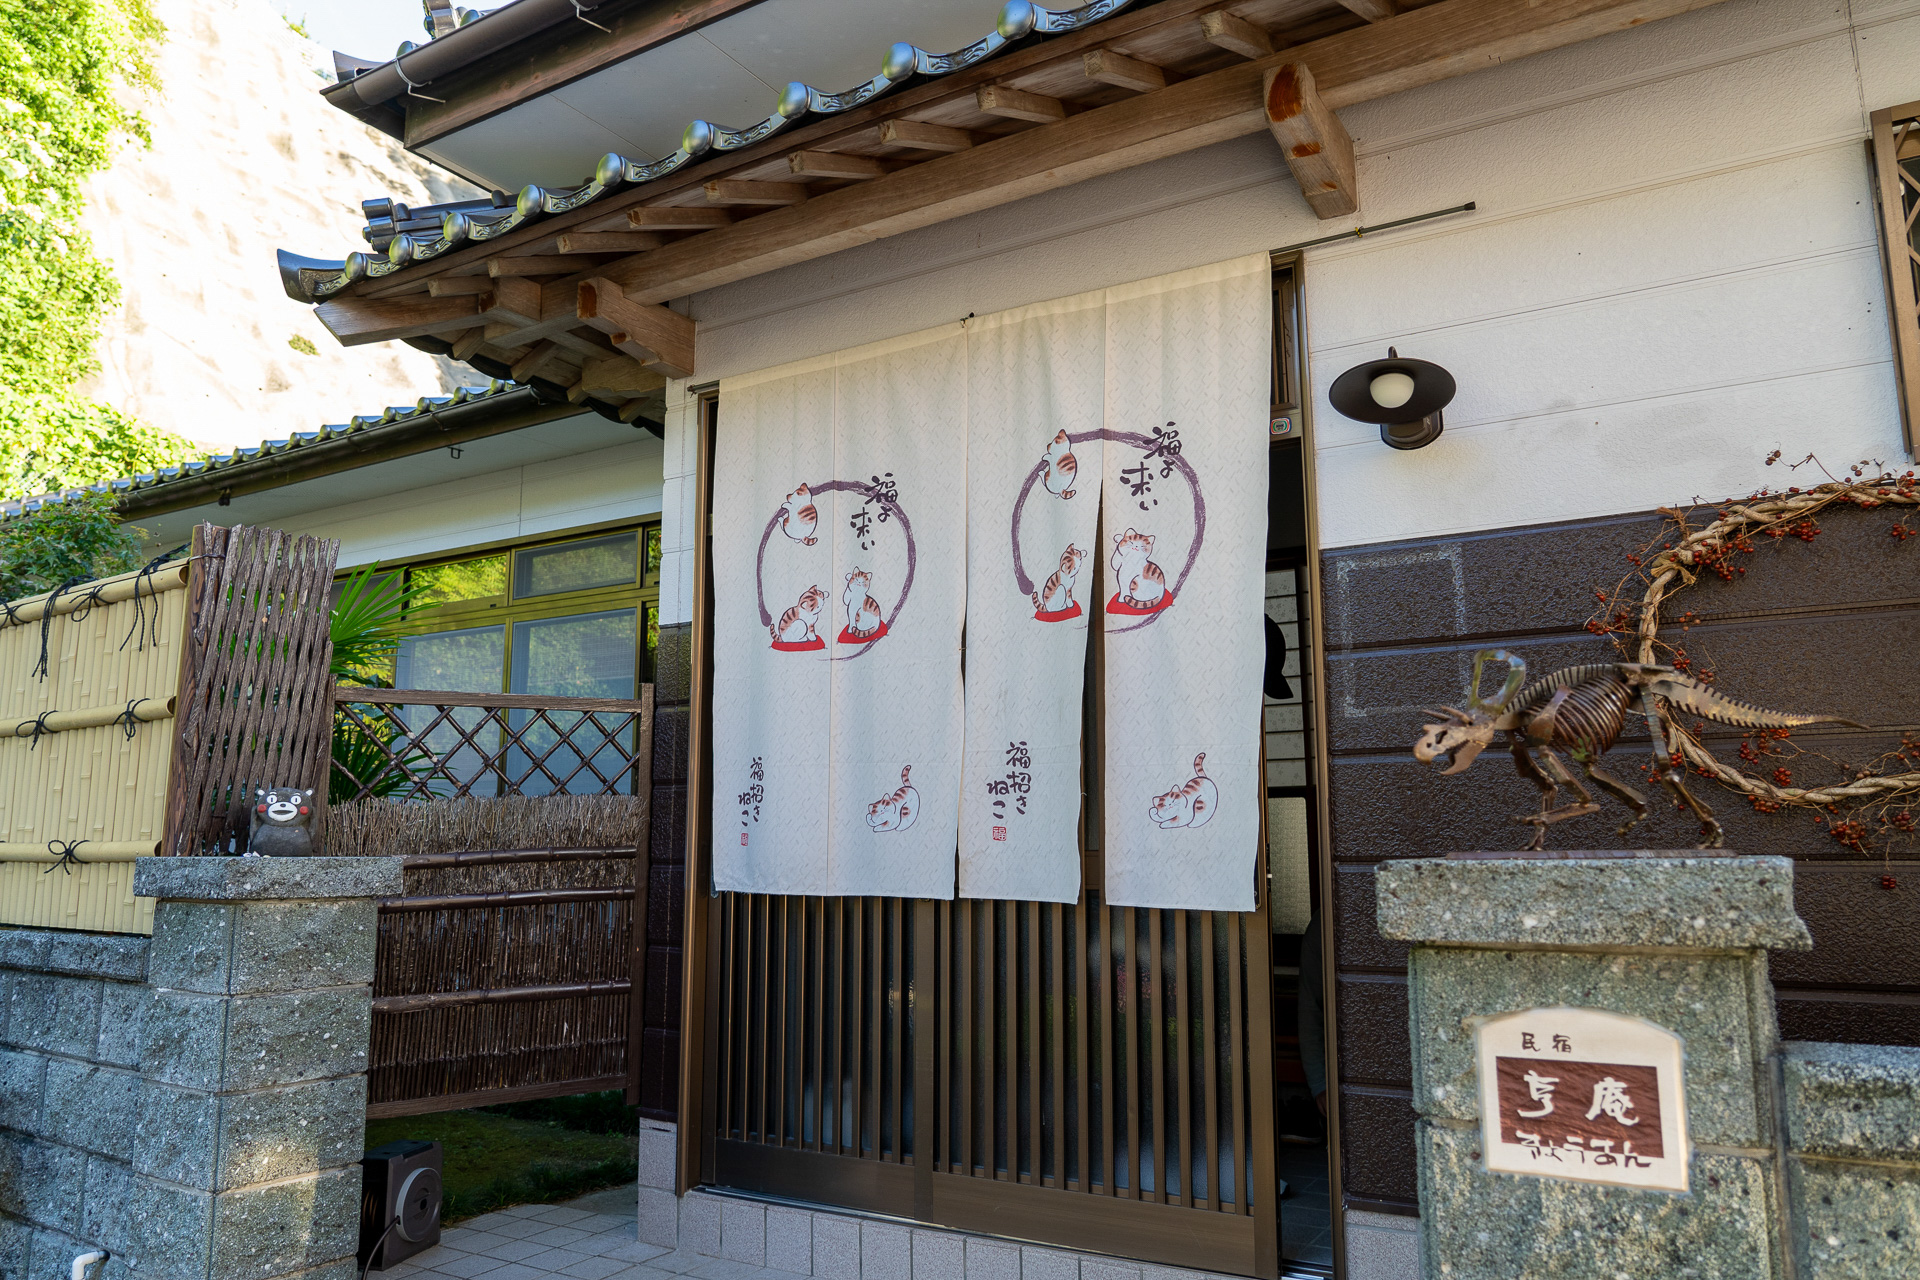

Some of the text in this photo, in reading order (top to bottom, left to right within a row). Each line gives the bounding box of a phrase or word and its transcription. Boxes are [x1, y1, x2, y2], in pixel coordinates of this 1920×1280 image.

[1119, 461, 1158, 511] 来い
[850, 506, 875, 551] 来い
[749, 756, 764, 823] 福招き
[1005, 741, 1031, 815] 福招き
[738, 791, 751, 827] ねこ
[986, 780, 1010, 819] ねこ
[1521, 1032, 1572, 1054] 民宿
[1514, 1130, 1652, 1168] きょうあん
